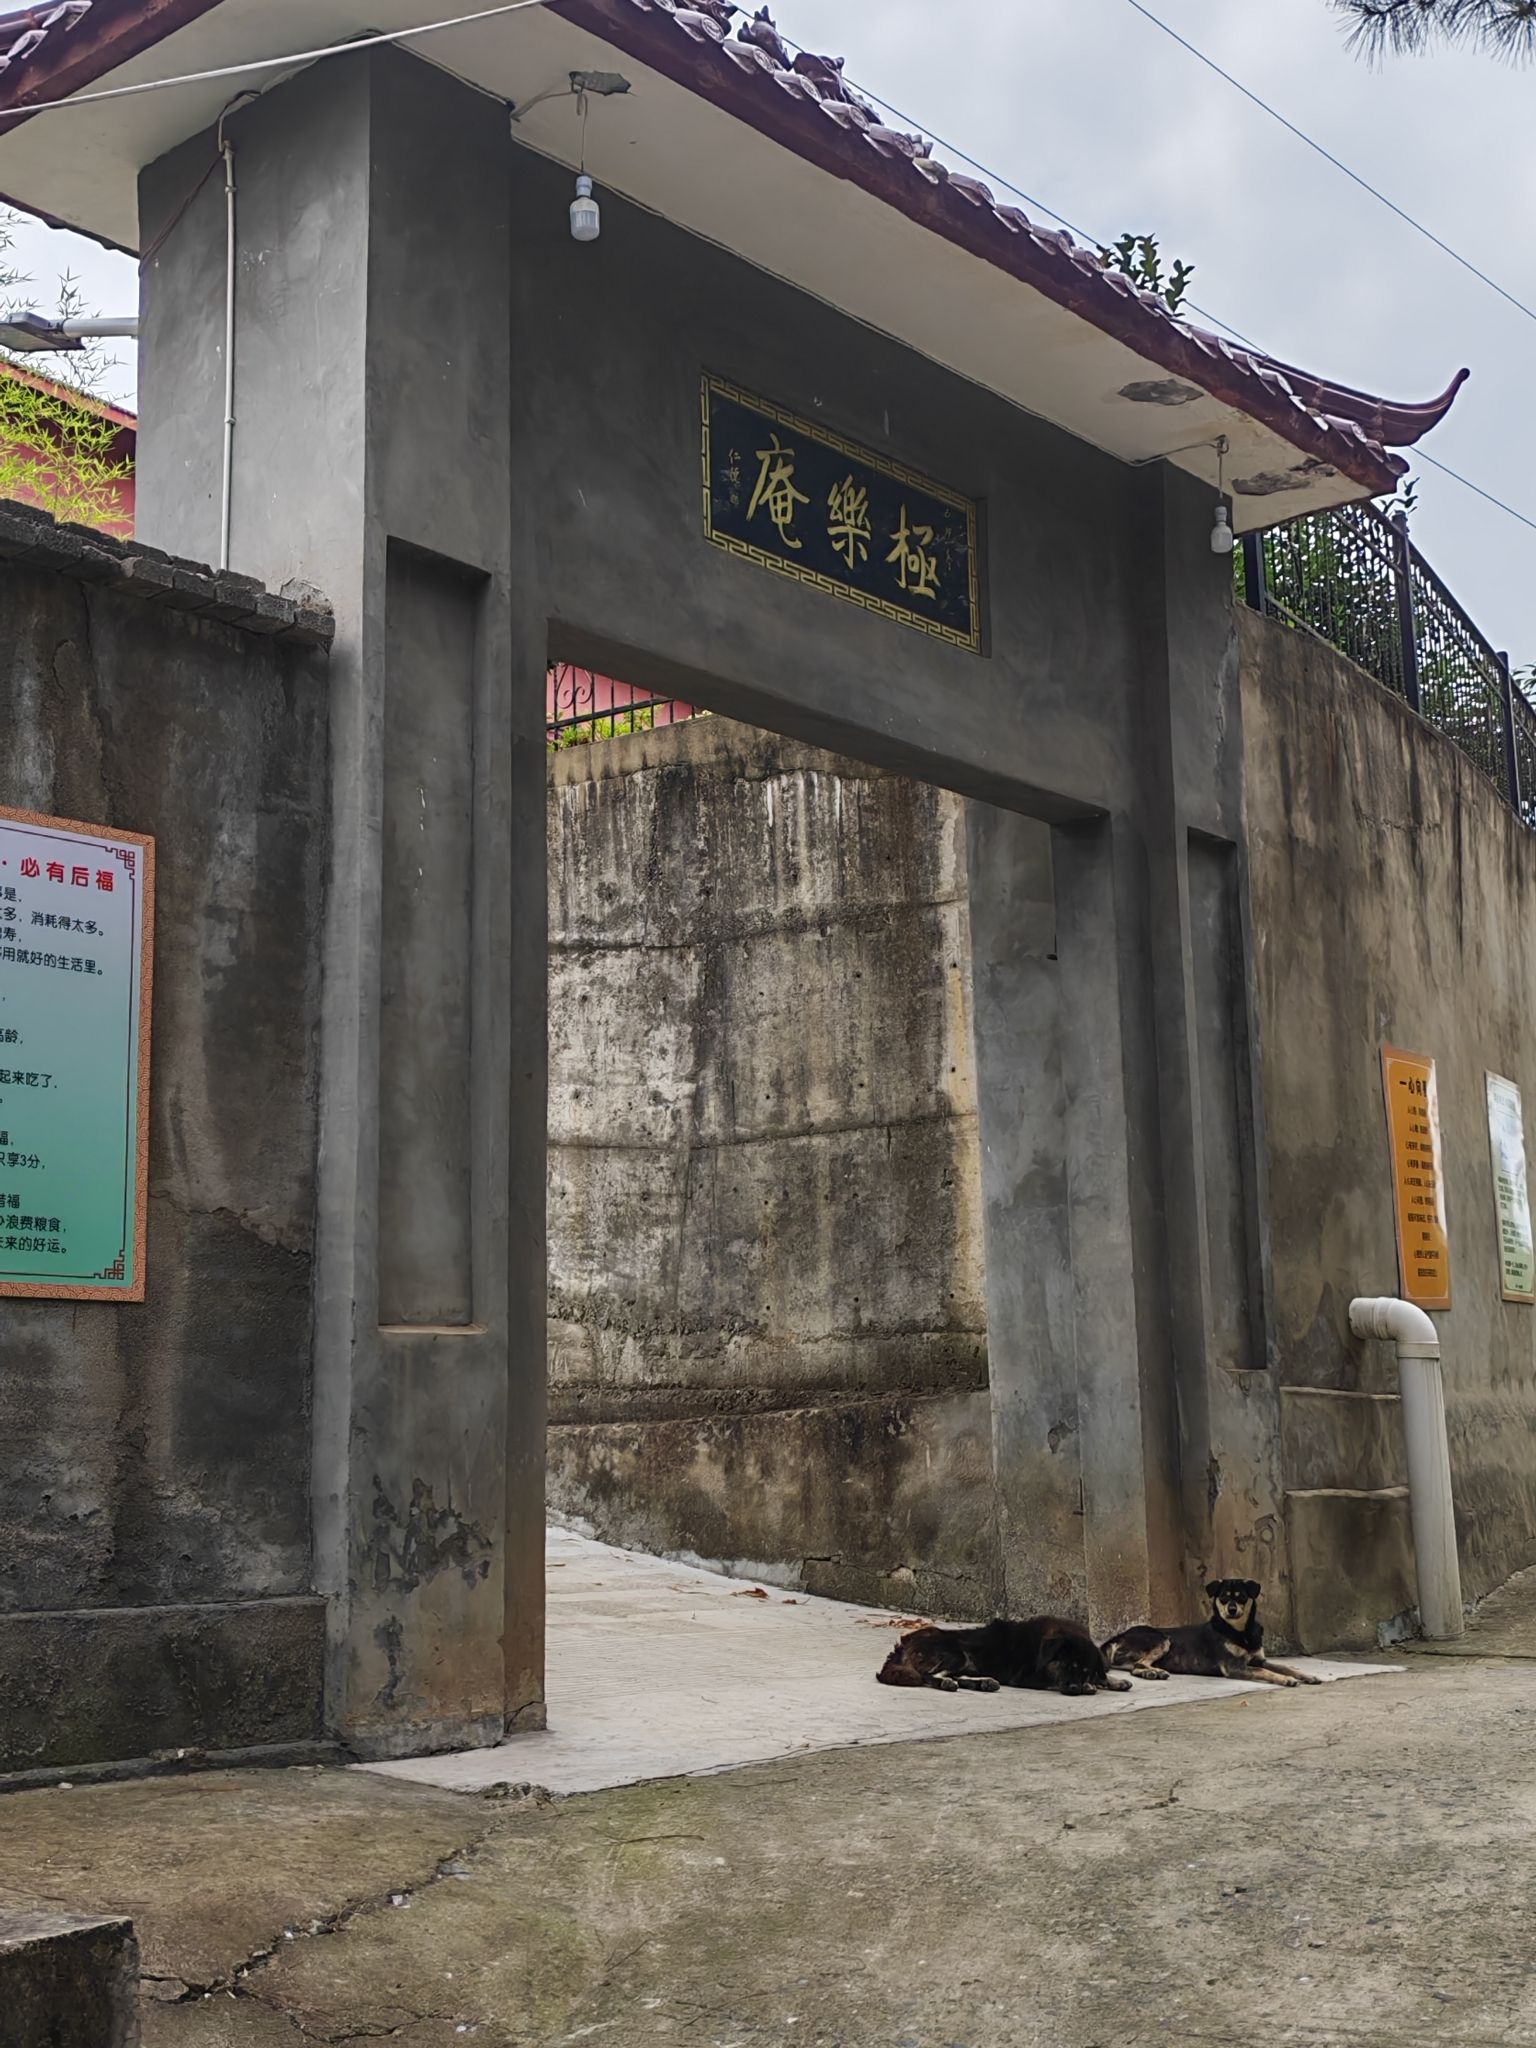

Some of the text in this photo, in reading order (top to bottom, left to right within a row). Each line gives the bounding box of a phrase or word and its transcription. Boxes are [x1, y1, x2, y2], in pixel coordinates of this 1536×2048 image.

[0, 906, 104, 937] 多，消耗得太多。
[0, 926, 22, 942] 寿，
[0, 946, 103, 976] 用就好的生活里。
[0, 1235, 67, 1254] 来的好运。
